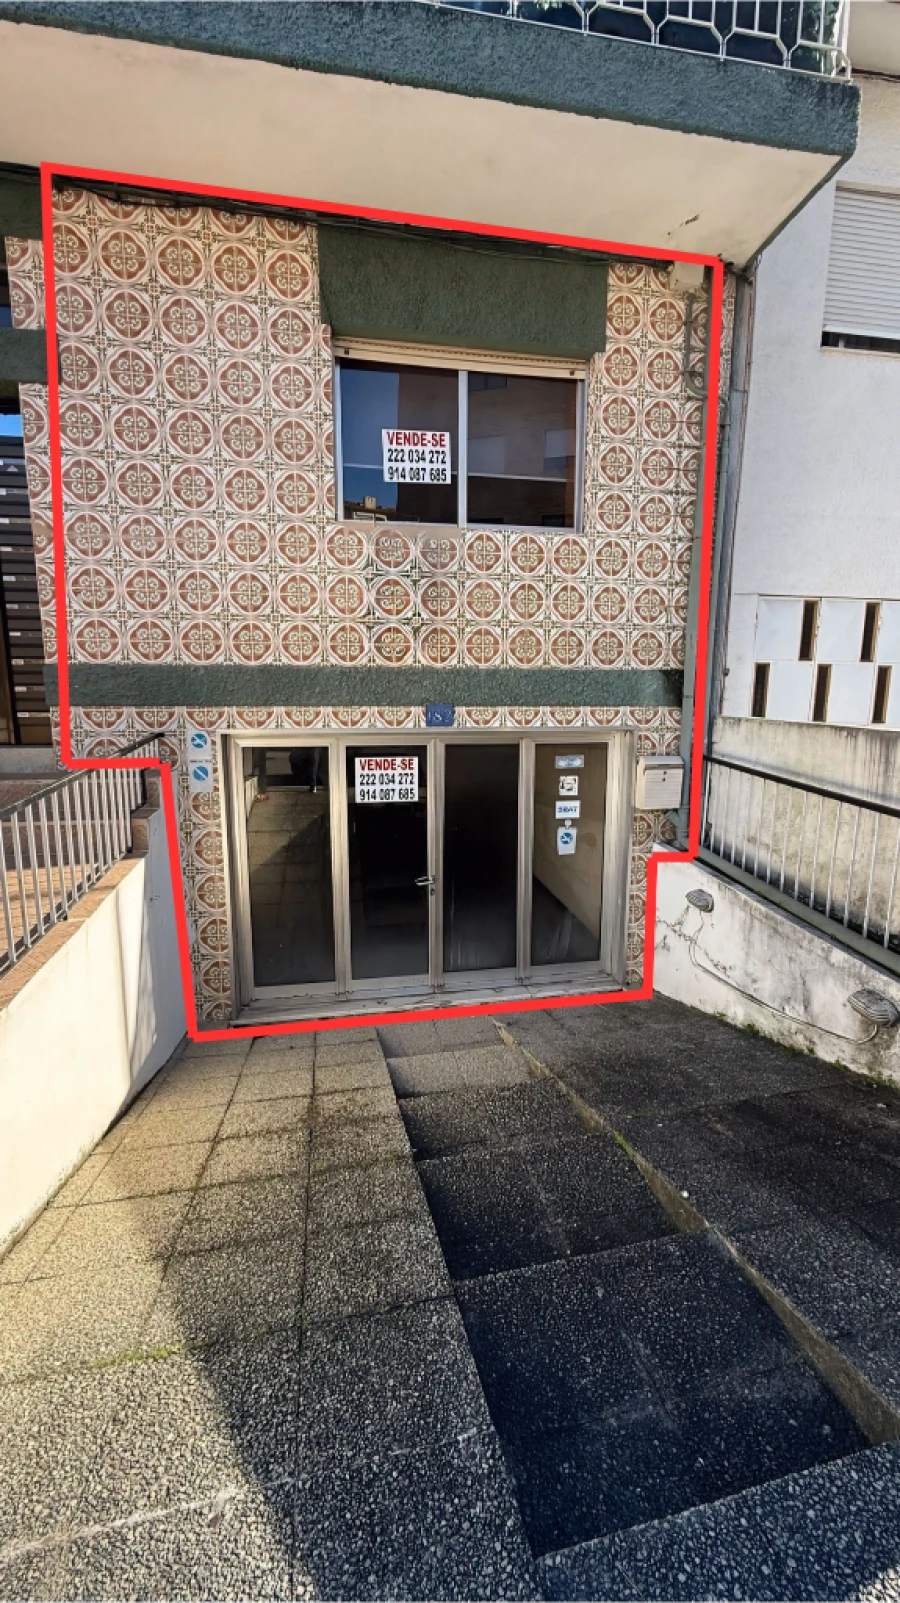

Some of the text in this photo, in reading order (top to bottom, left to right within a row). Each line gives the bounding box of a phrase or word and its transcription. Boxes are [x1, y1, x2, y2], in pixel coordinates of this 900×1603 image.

[386, 431, 446, 447] VENDE-SE
[387, 448, 446, 464] 222 034 272
[387, 466, 447, 482] 914 087 685
[359, 758, 414, 771] VENDE-SE
[359, 772, 414, 786] 222 034 272
[359, 788, 415, 802] 914 087 685
